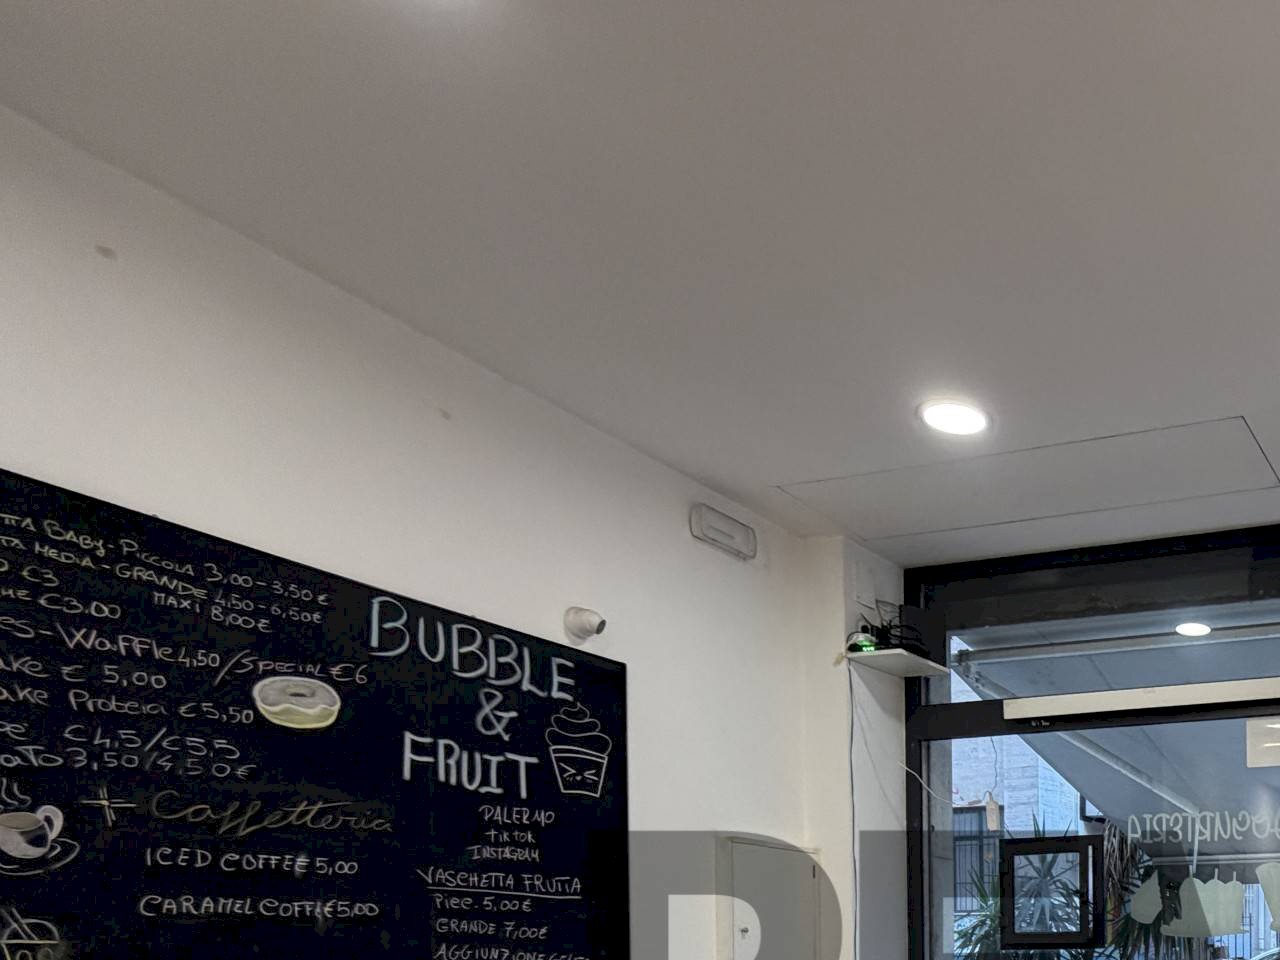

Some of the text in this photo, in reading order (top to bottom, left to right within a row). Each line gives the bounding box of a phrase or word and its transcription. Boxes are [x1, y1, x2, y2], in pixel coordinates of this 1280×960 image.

[116, 563, 208, 599] GRANDE
[369, 596, 576, 702] BUBBLE
[475, 688, 519, 742] &
[402, 731, 540, 799] FRUIT
[152, 790, 393, 836] Caffetteria
[478, 804, 556, 827] PALERMO
[145, 847, 212, 868] ICED
[415, 866, 582, 895] VASCHETTA FRUTTA
[140, 895, 253, 917] CARAMEL
[435, 918, 497, 935] GRANDE
